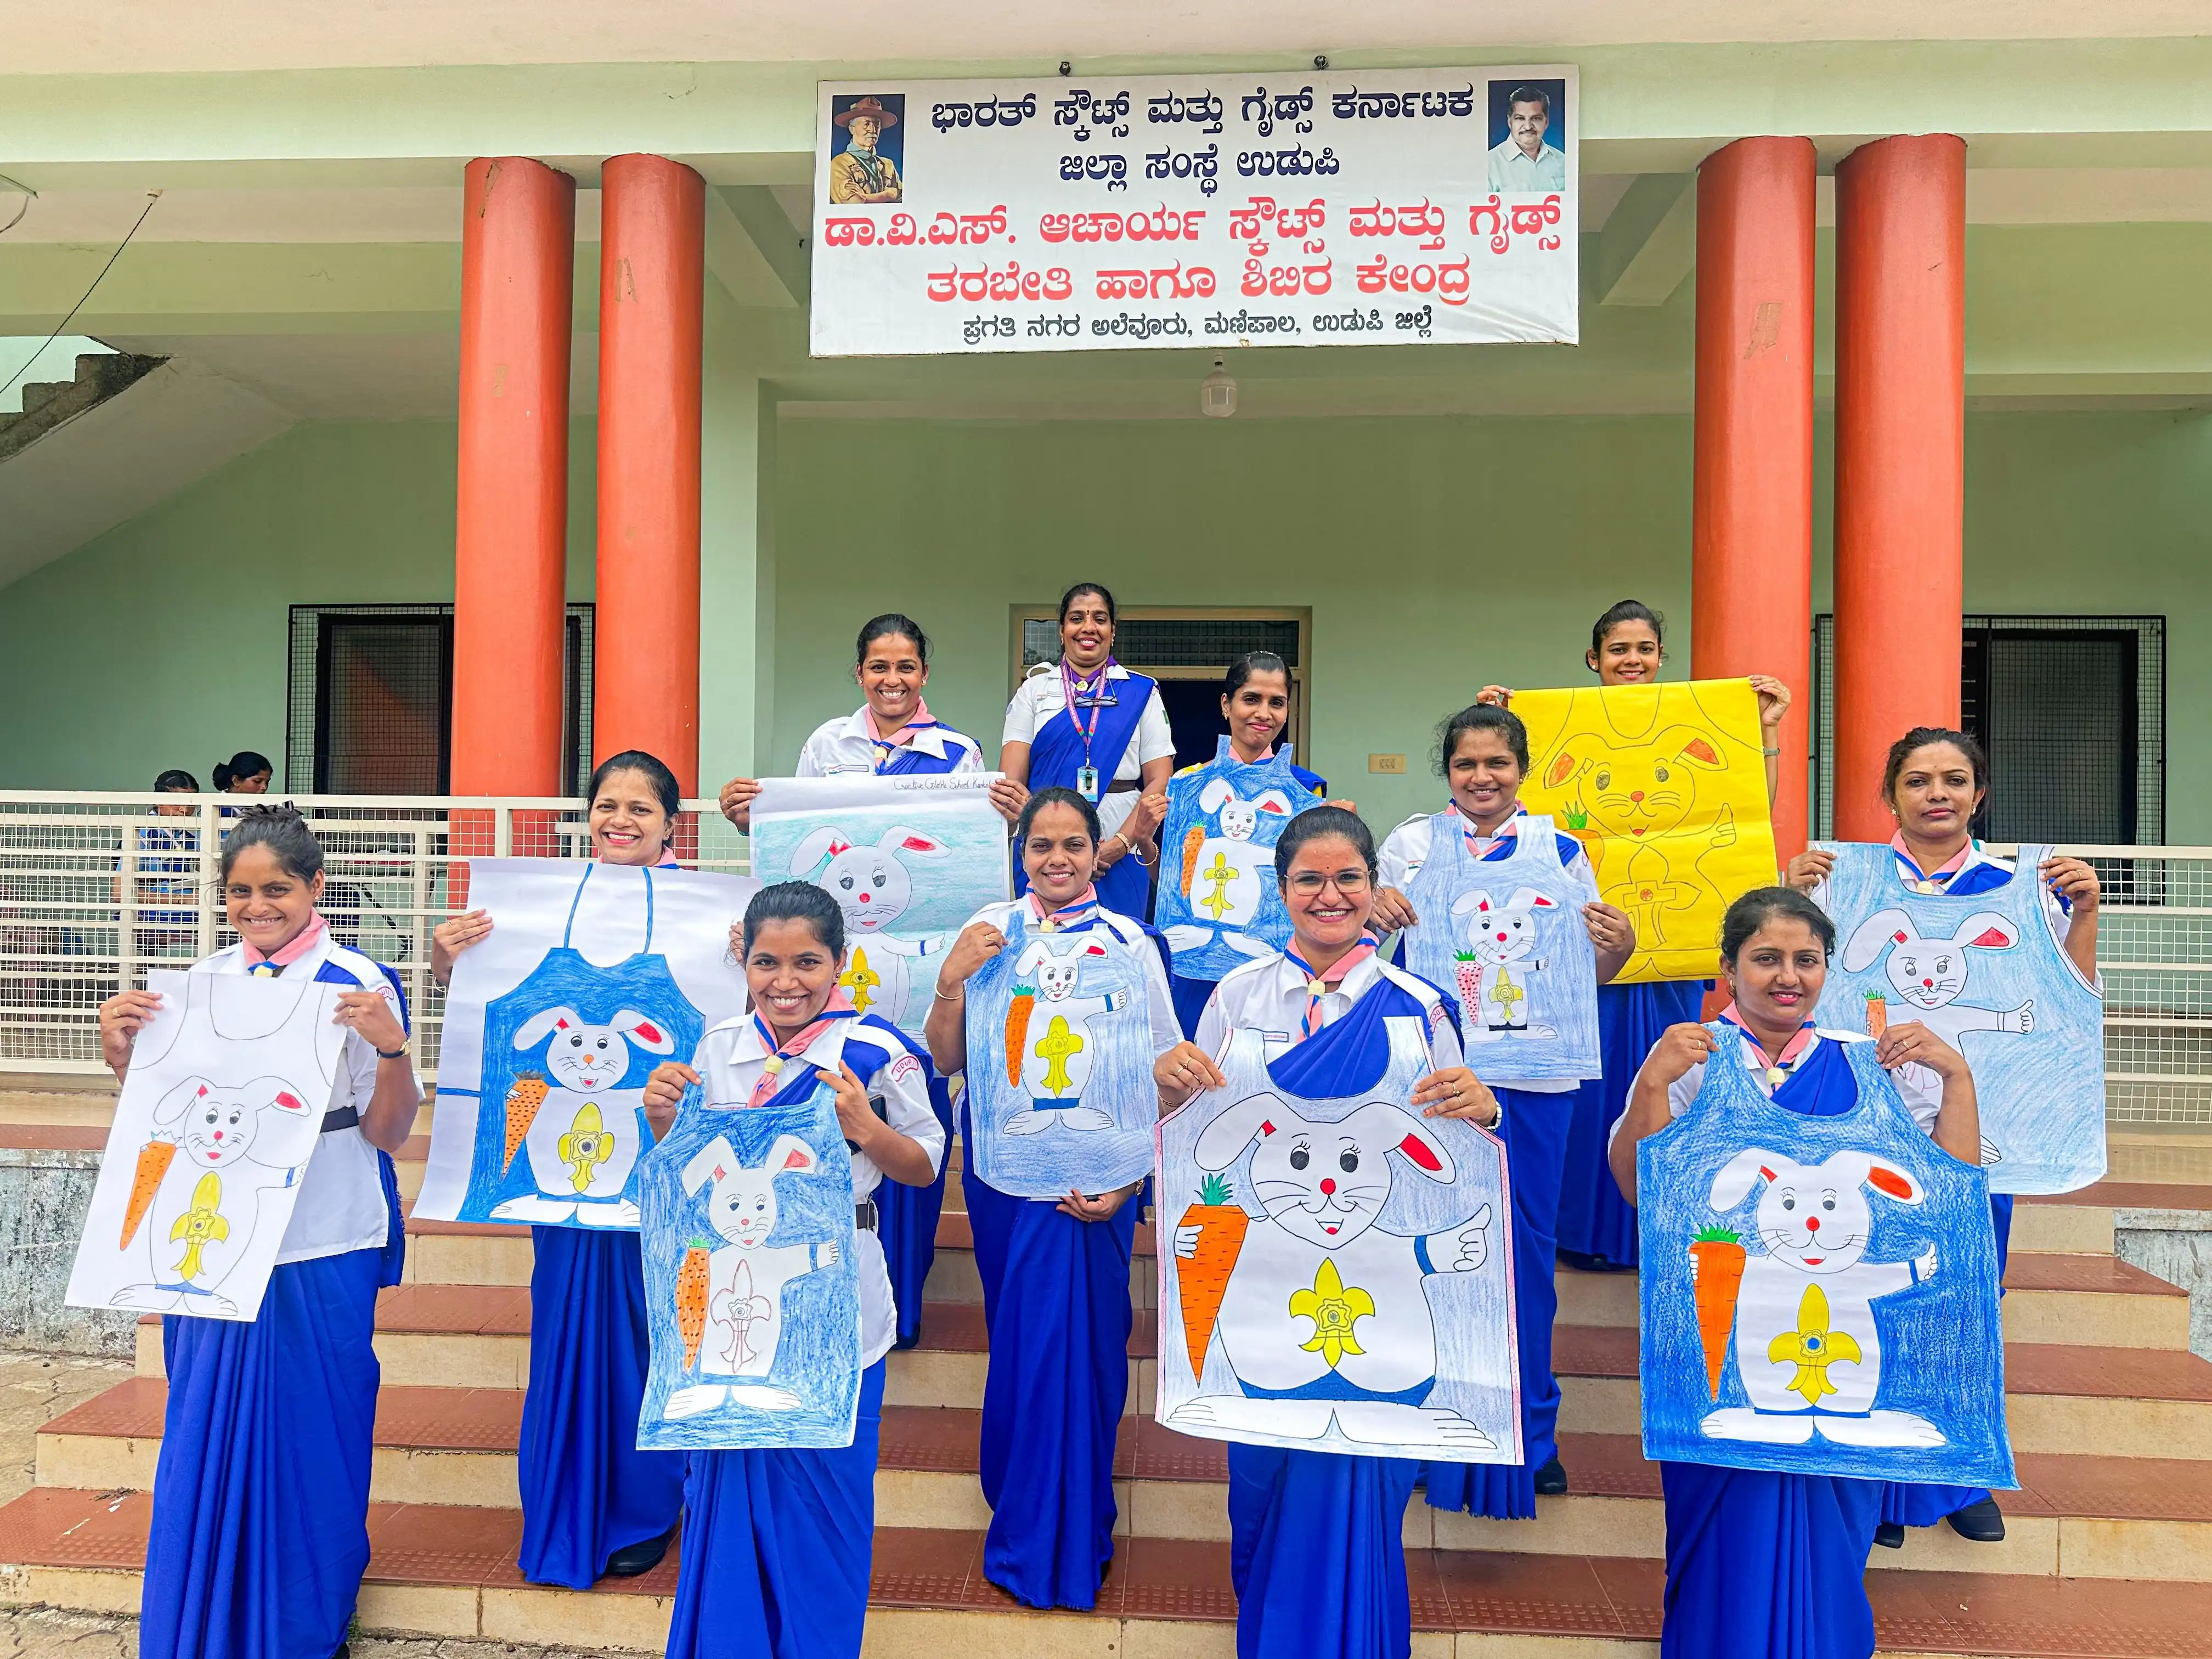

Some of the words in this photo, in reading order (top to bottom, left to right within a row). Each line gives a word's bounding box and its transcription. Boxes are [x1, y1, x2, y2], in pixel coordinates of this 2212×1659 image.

[932, 93, 1036, 134] ಭಾರತ್
[1054, 89, 1130, 142] ಸ್ಕೌಟ್ಸ್
[1148, 88, 1223, 135] ಮತ್ತು
[1242, 86, 1313, 137] ಗೈಡ್ಸ್
[1331, 82, 1474, 119] ಕರ್ನಾಟಕ
[1059, 154, 1127, 192] ಜಿಲ್ಲಾ
[1146, 143, 1218, 198] ಸಂಸ್ಥೆ
[1237, 141, 1340, 177] ಉಡುಪಿ
[825, 205, 1016, 247] ಡಾ.ವಿ.ಎಸ್.
[1040, 201, 1206, 243] ಆಚಾರ್ಯ
[1229, 196, 1325, 257] ಸ್ಕೌಟ್ಸ್
[1349, 195, 1446, 250] ಮತ್ತು
[1469, 194, 1561, 255] ಗೈಡ್ಸ್
[927, 261, 1073, 302] ತರಬೇತಿ
[1096, 259, 1216, 300] ಹಾಗೂ
[1241, 256, 1332, 297] ಶಿಬಿರ
[1356, 253, 1470, 306] ಕೇಂದ್ರ
[963, 314, 1016, 345] ಪ್ರಗತಿ
[1027, 314, 1080, 337] ನಗರ
[1091, 312, 1193, 340] ಅಲೆವೂರು,
[1204, 309, 1301, 335] ಮಣಿಪಾಲ,
[1313, 308, 1384, 332] ಉಡುಪಿ
[1395, 304, 1432, 338] ಜಿಲ್ಲೆ
[895, 1059, 915, 1073] UDUPI
